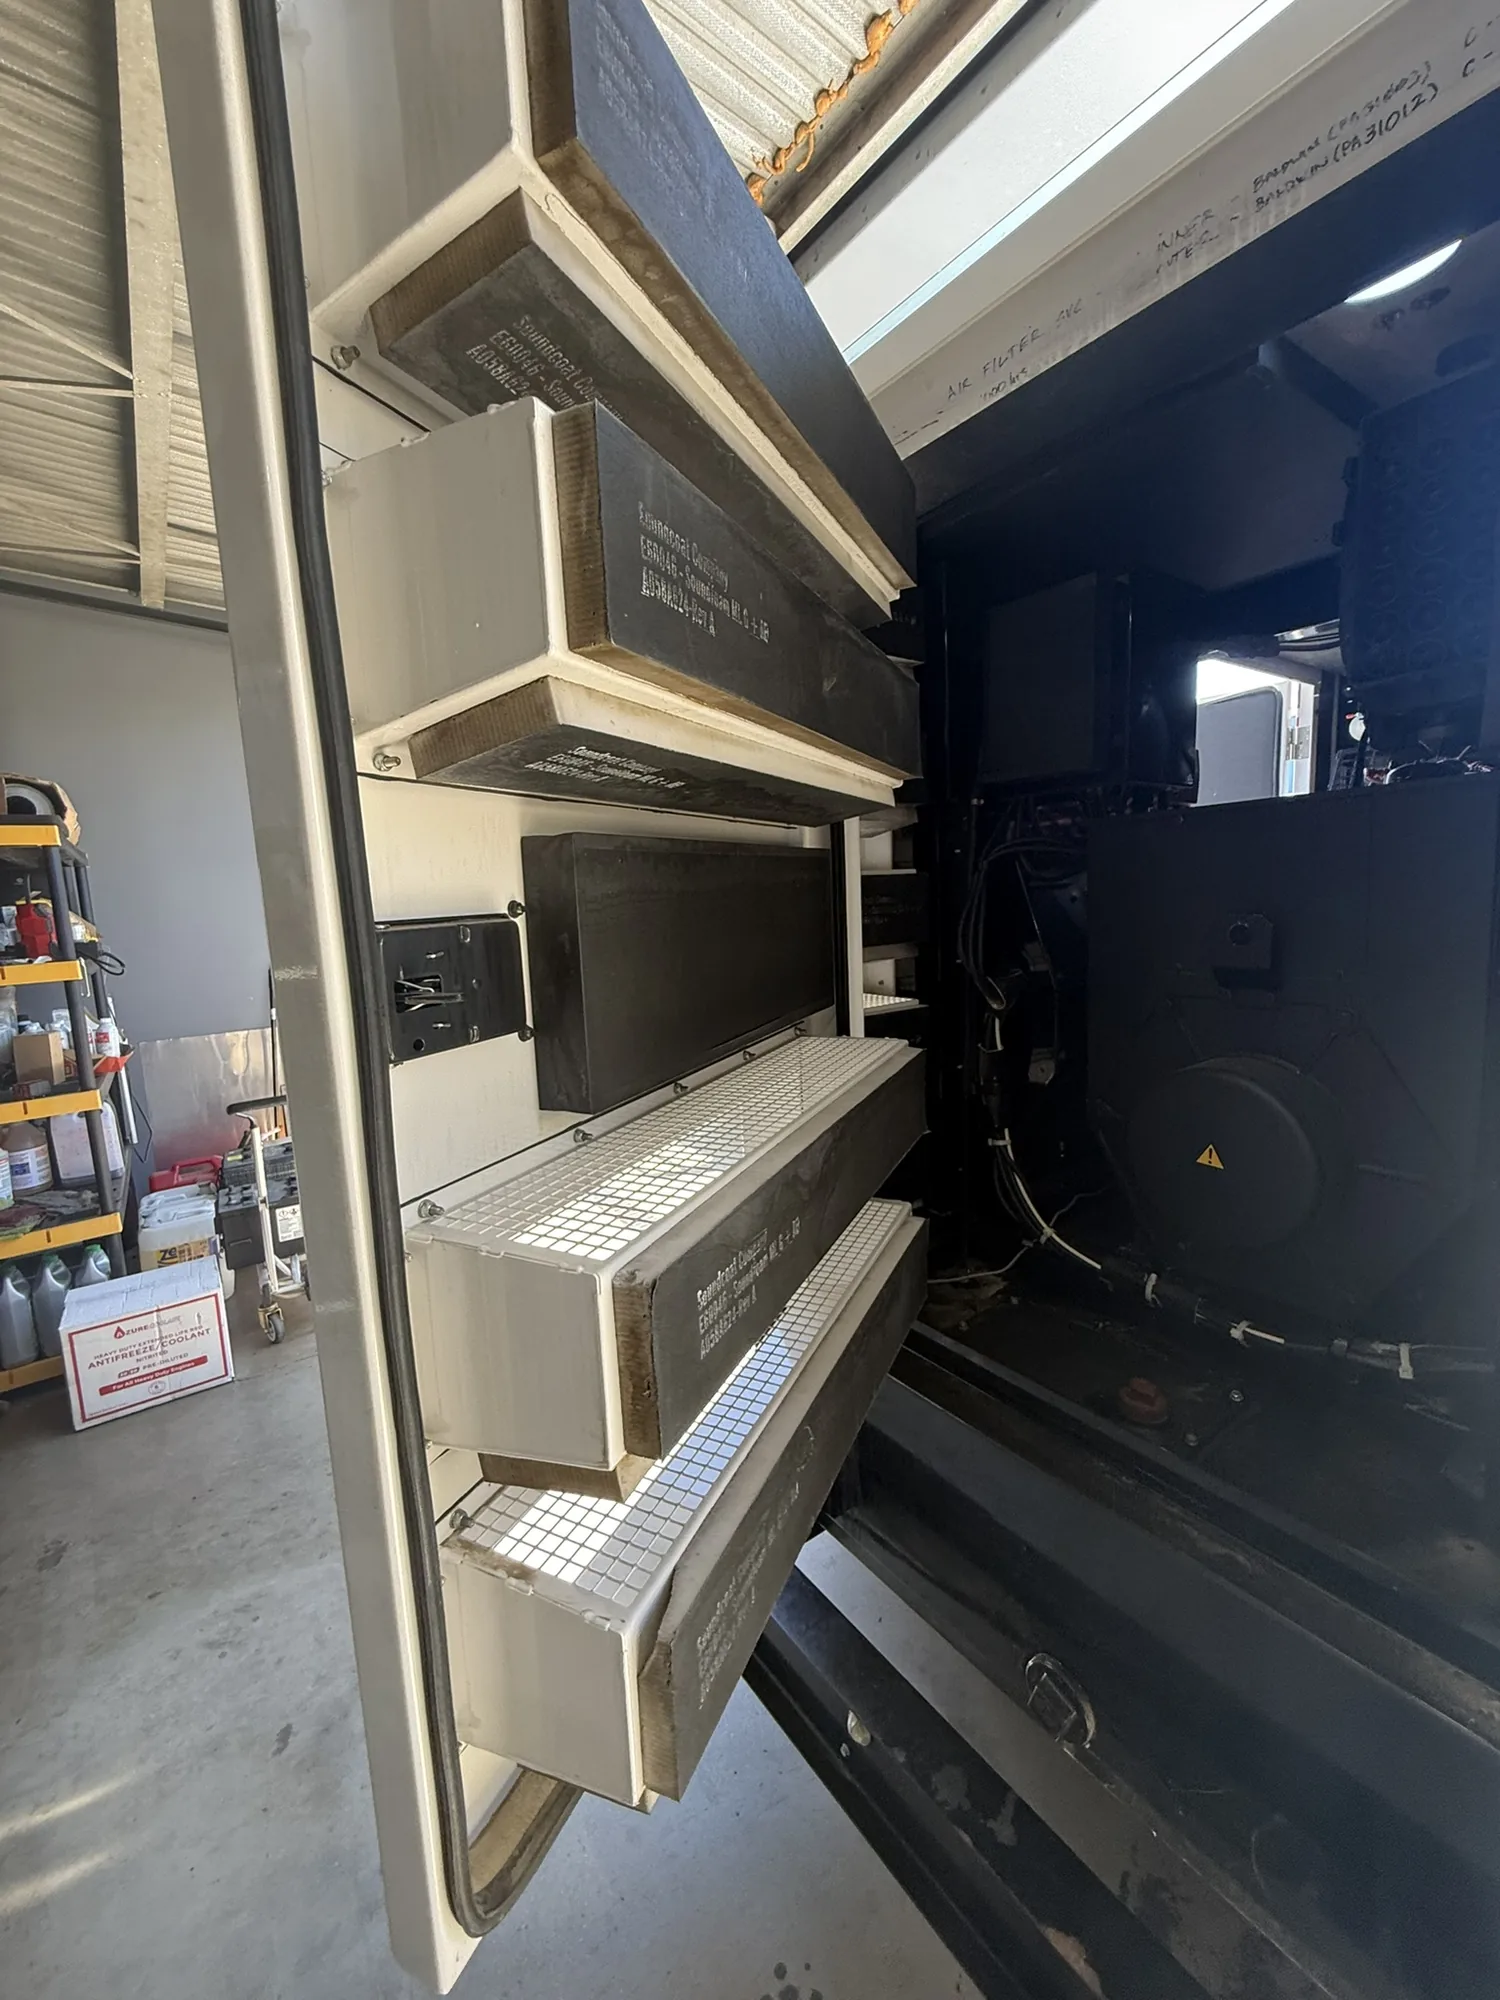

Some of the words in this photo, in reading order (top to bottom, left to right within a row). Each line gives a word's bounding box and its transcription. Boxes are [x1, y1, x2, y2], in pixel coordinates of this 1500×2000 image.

[982, 327, 1046, 377] FILTER
[88, 1327, 211, 1370] ANTIFREEZE/COOLANT
[118, 1343, 137, 1353] DUTY
